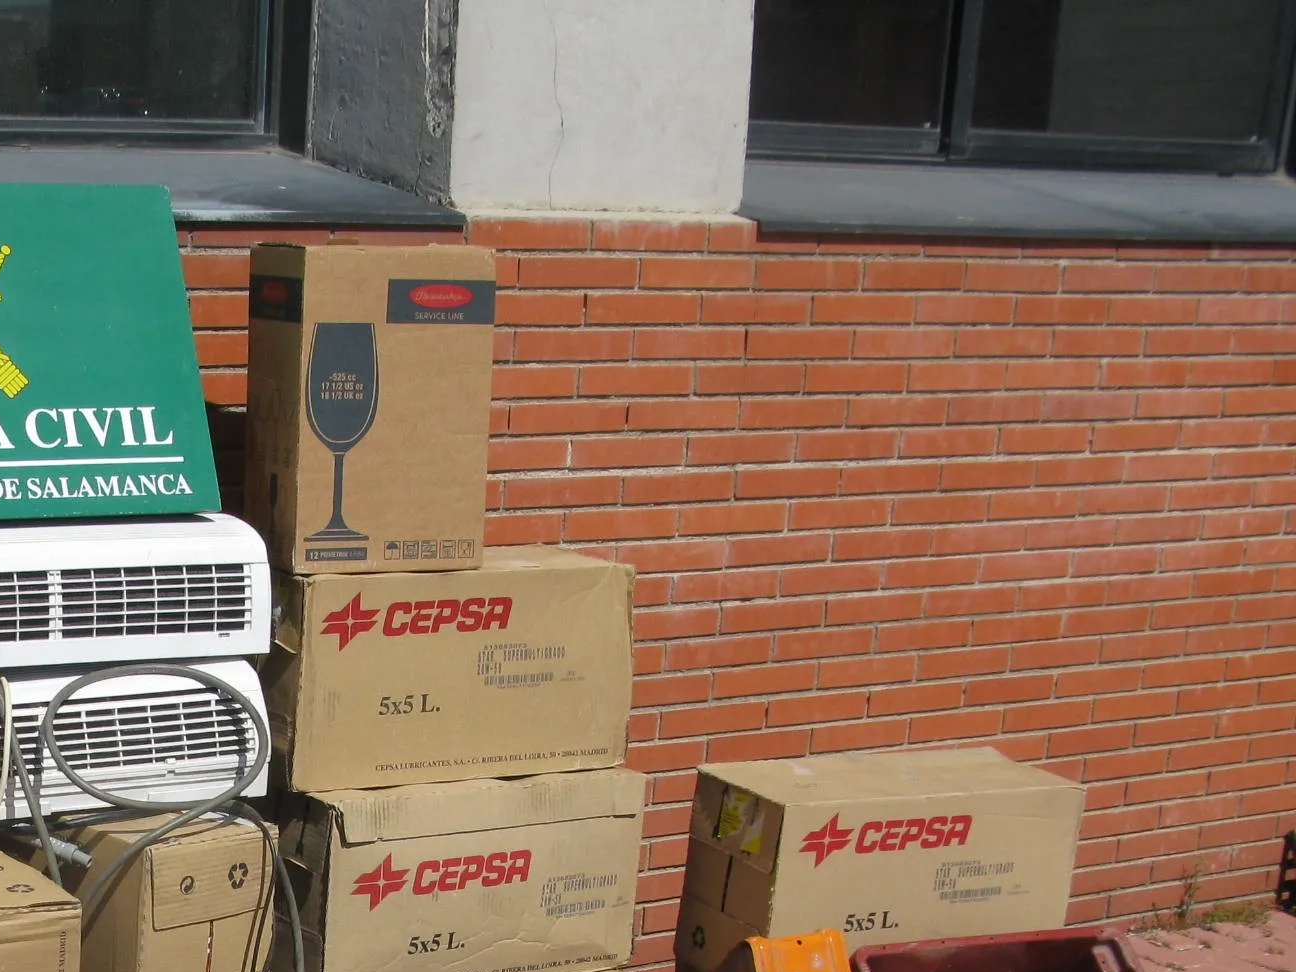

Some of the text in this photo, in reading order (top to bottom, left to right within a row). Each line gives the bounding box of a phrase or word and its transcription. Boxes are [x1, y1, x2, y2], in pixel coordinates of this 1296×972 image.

[415, 311, 465, 321] SERVICE LINE
[321, 381, 330, 390] 17
[344, 381, 354, 390] US
[25, 406, 174, 449] CIVIL
[28, 474, 193, 500] SALAMANCA
[382, 596, 513, 637] CEPSA
[378, 693, 442, 716] 5x5 L.
[375, 763, 400, 772] CEPSA
[509, 753, 523, 762] DEL
[579, 748, 608, 757] MADRID
[855, 814, 973, 855] CEPSA
[412, 849, 532, 896] CEPSA
[843, 910, 899, 933] 5x5 L.
[407, 931, 465, 956] 5x5 L.
[527, 963, 540, 972] DEL
